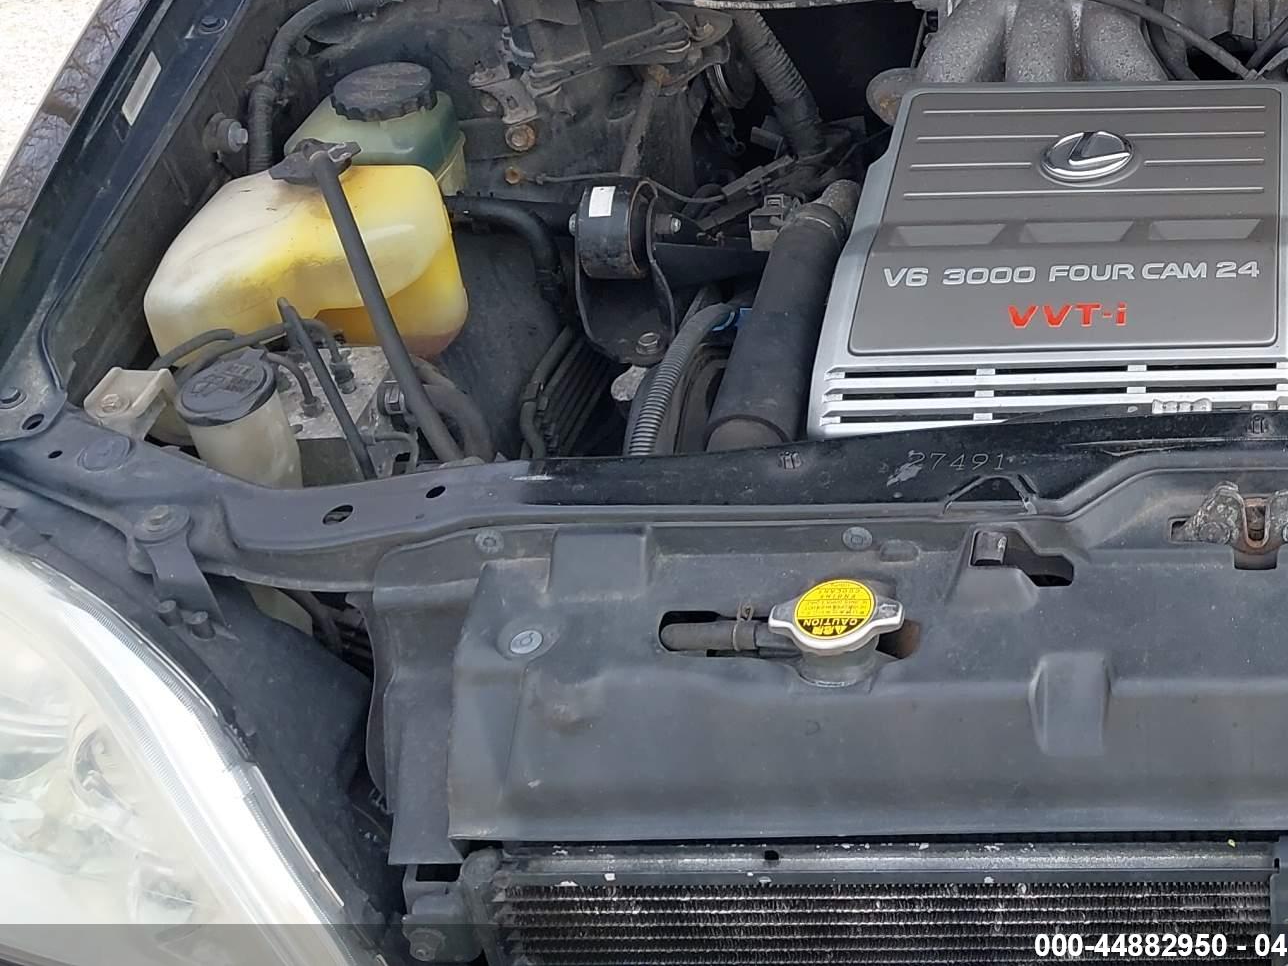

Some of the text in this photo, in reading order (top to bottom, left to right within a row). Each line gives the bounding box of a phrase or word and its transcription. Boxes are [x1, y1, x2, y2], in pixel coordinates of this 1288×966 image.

[884, 261, 1260, 287] V6 3000 FOUR CAM 24
[1007, 302, 1128, 329] VVT-i
[802, 618, 859, 627] CAUTION
